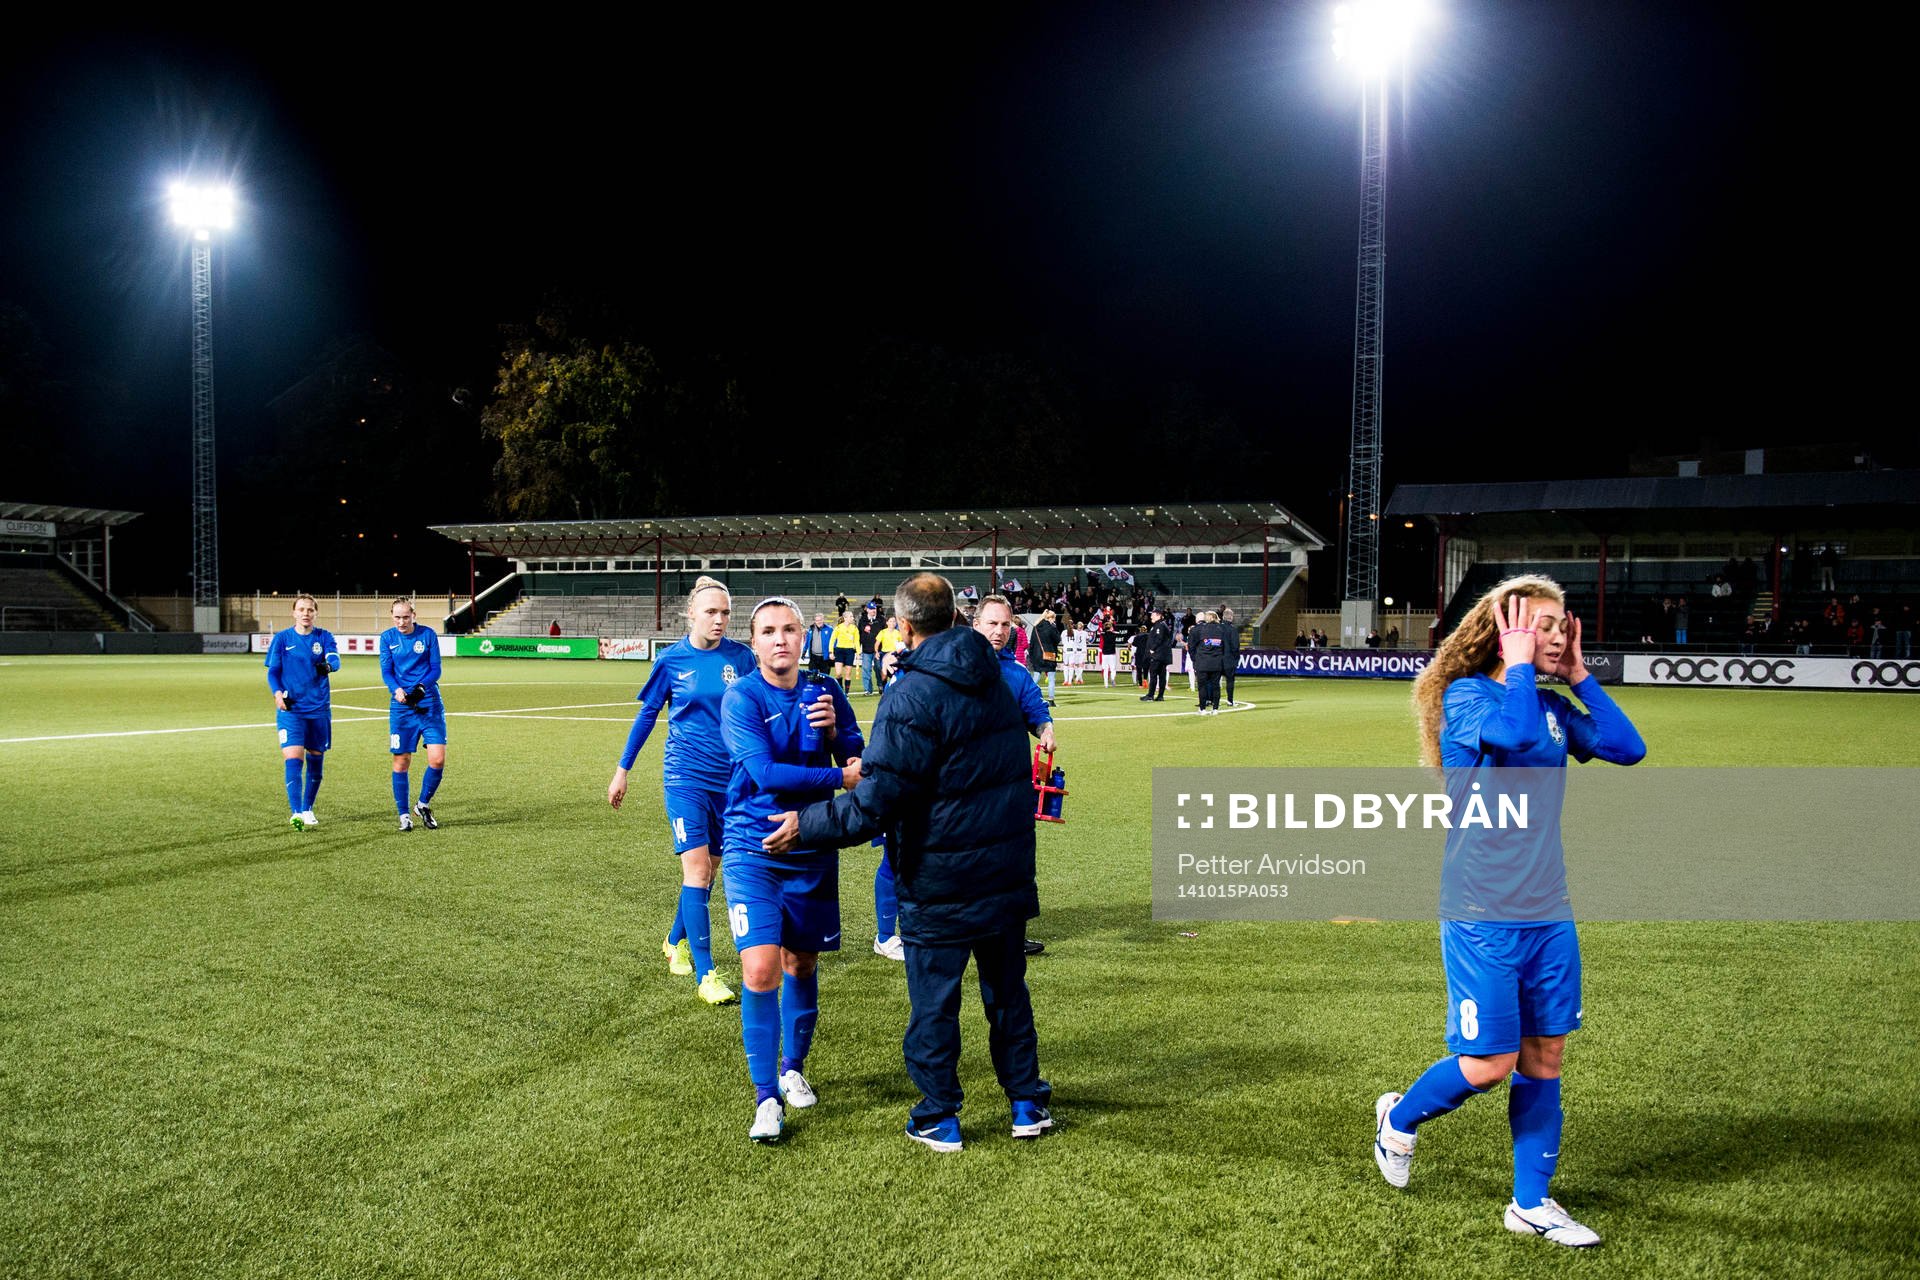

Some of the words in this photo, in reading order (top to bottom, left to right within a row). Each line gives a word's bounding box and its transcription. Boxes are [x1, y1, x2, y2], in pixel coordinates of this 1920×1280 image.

[1236, 654, 1314, 671] WOMEN'S
[1318, 655, 1425, 673] CHAMPIONS
[1459, 998, 1479, 1040] 8
